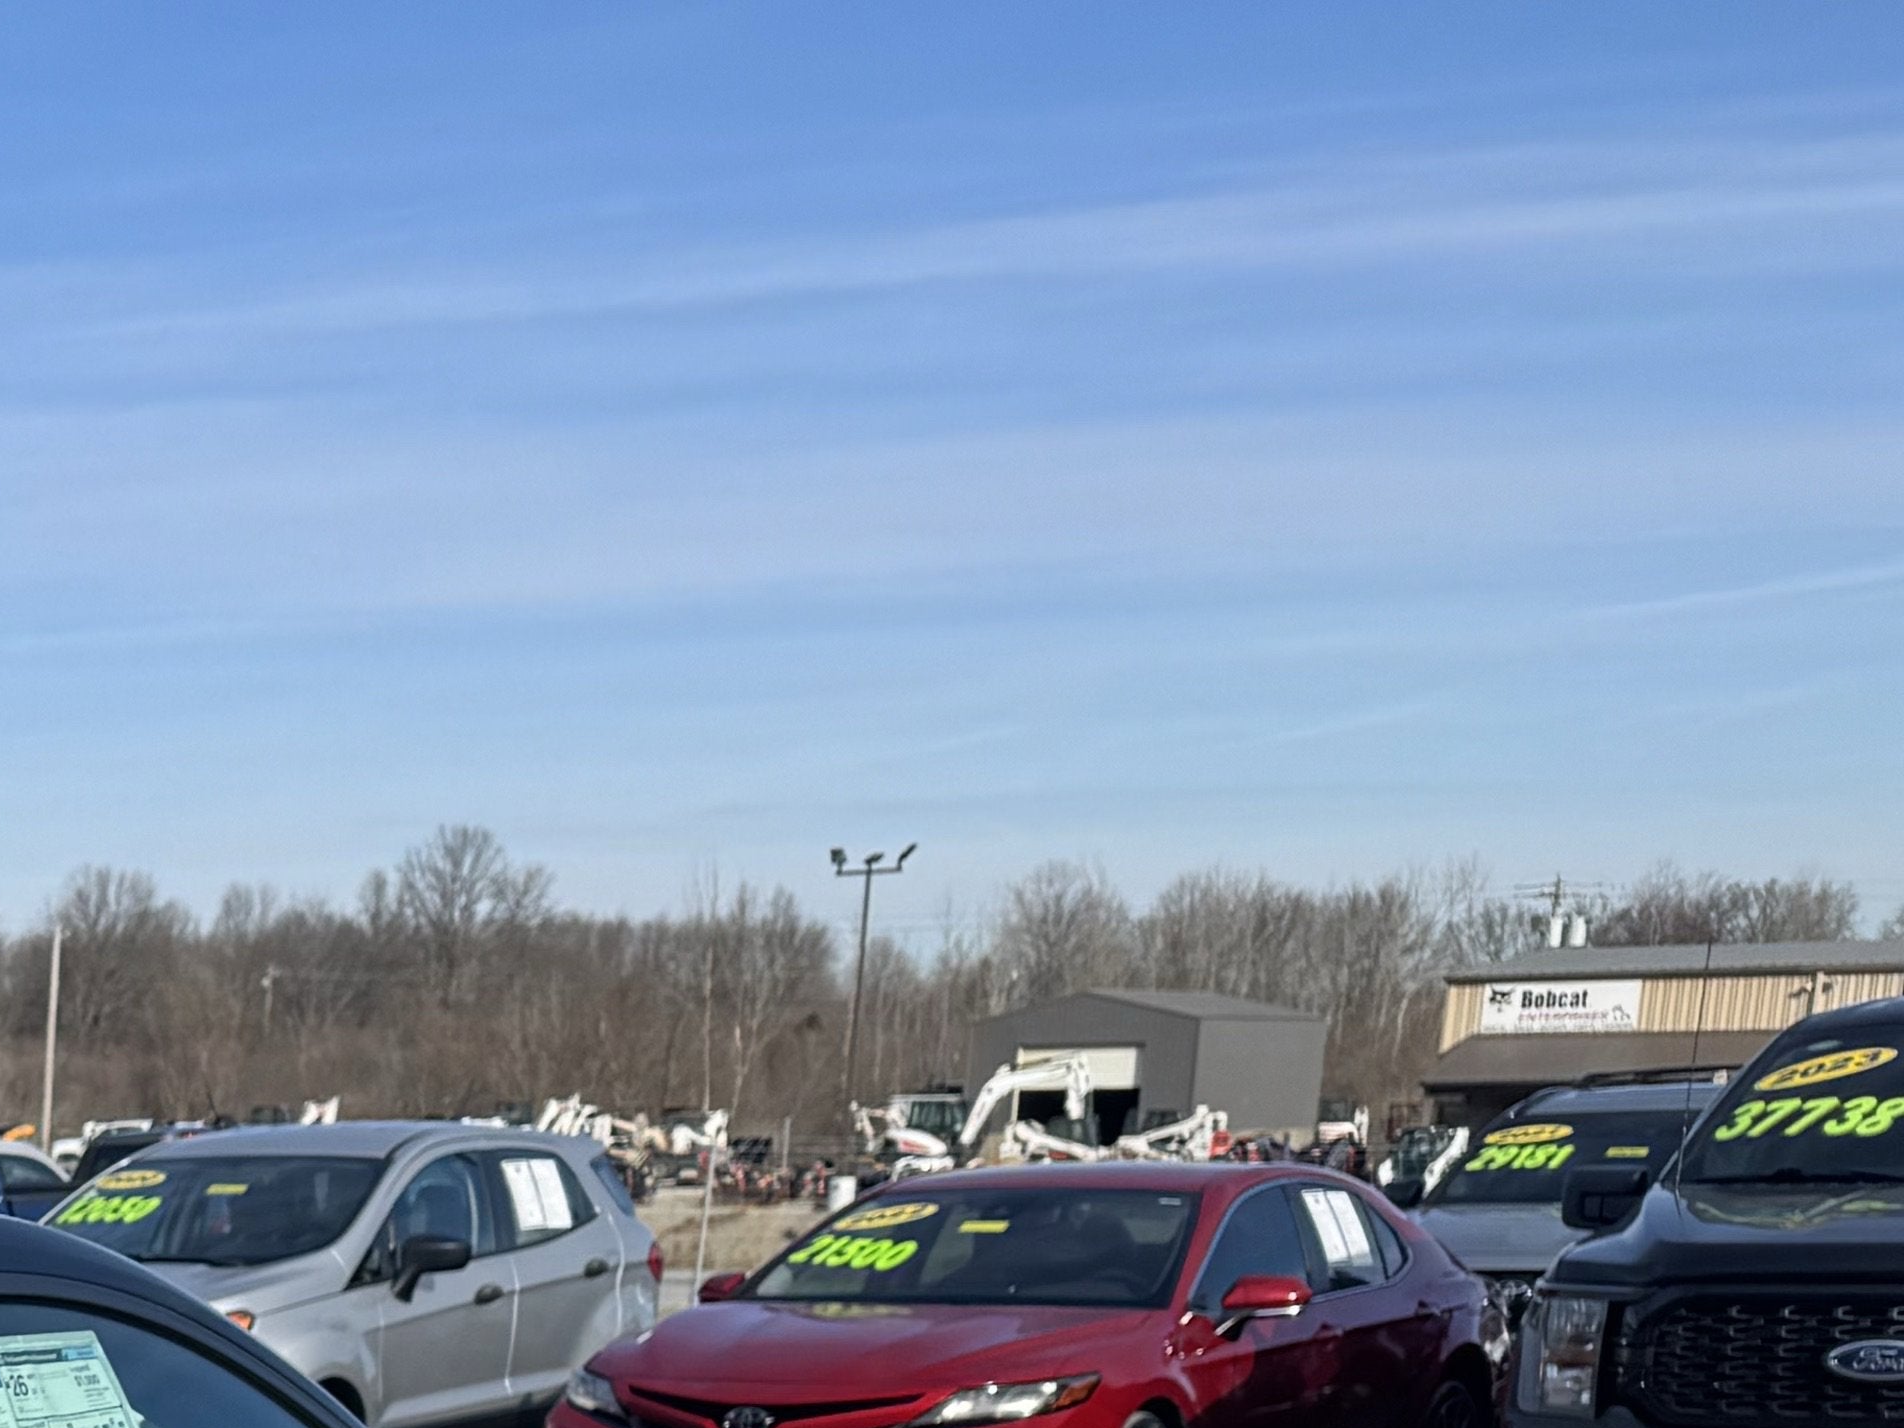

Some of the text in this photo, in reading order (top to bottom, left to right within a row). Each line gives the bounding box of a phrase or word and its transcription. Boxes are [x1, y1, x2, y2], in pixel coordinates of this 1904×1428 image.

[1520, 989, 1589, 1009] Bobcat
[1770, 1049, 1884, 1085] 2023
[1714, 1096, 1904, 1141] 37738
[787, 1233, 919, 1272] 21500
